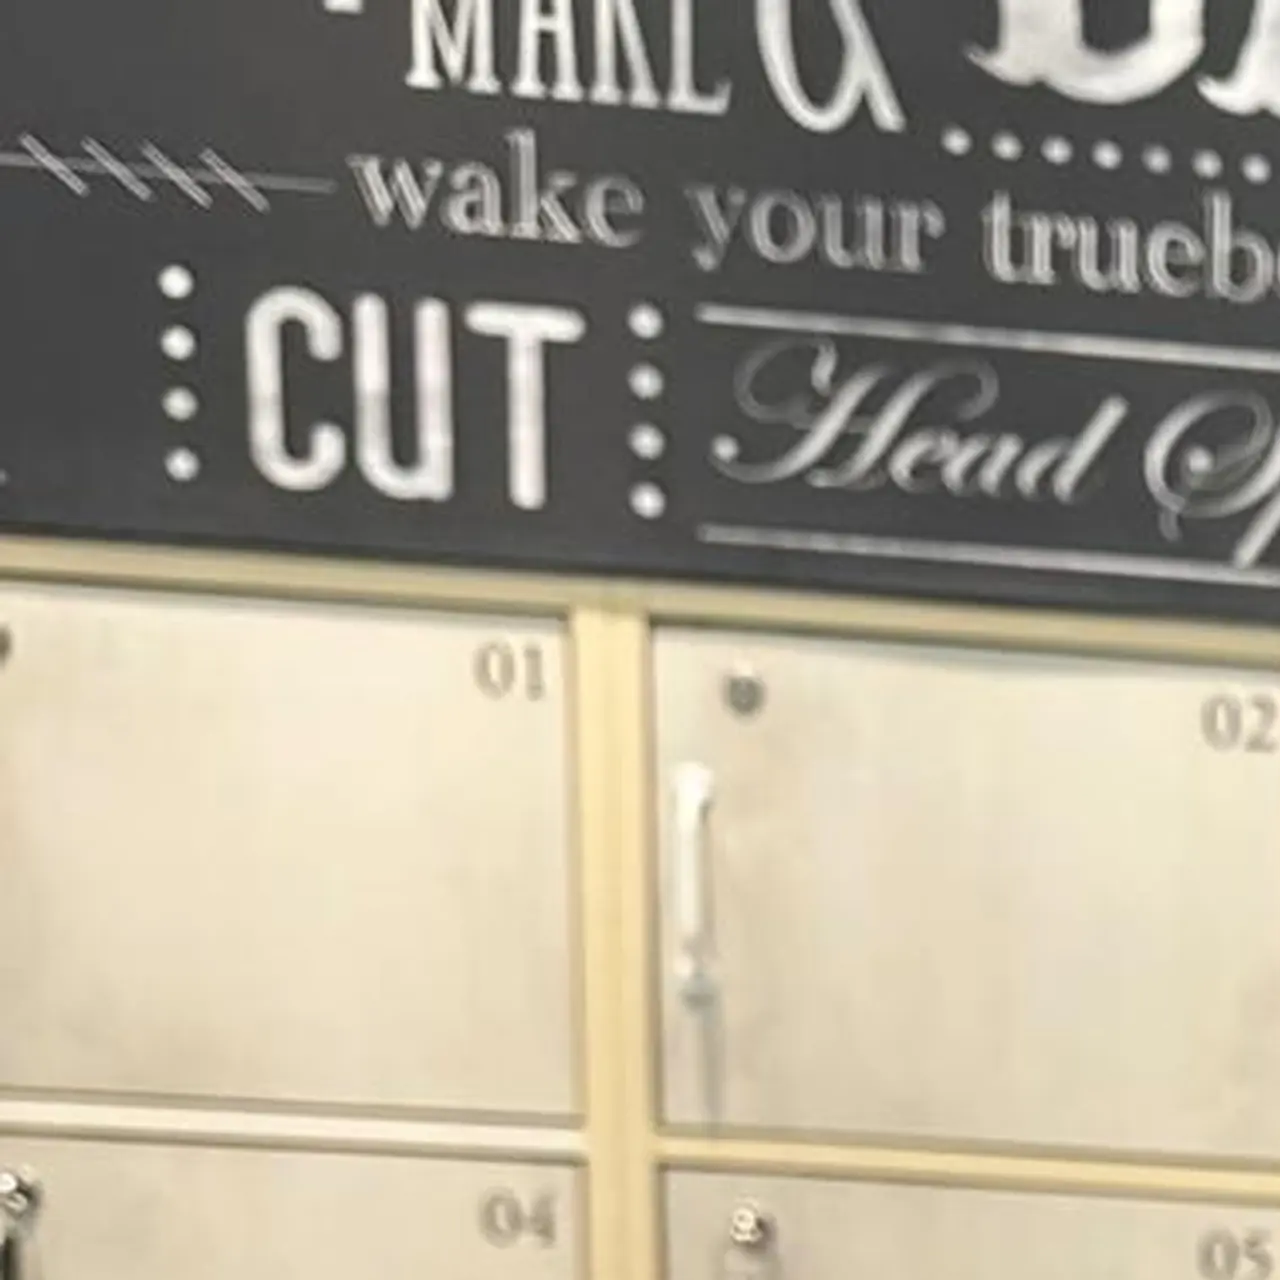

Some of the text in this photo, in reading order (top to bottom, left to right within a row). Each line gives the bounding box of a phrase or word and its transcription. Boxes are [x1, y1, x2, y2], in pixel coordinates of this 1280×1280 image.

[346, 128, 645, 249] wake
[683, 184, 947, 273] your
[245, 284, 586, 510] CUT
[708, 336, 1128, 503] Head
[474, 640, 546, 702] 01
[1200, 692, 1280, 754] 02
[480, 1186, 557, 1248] 04
